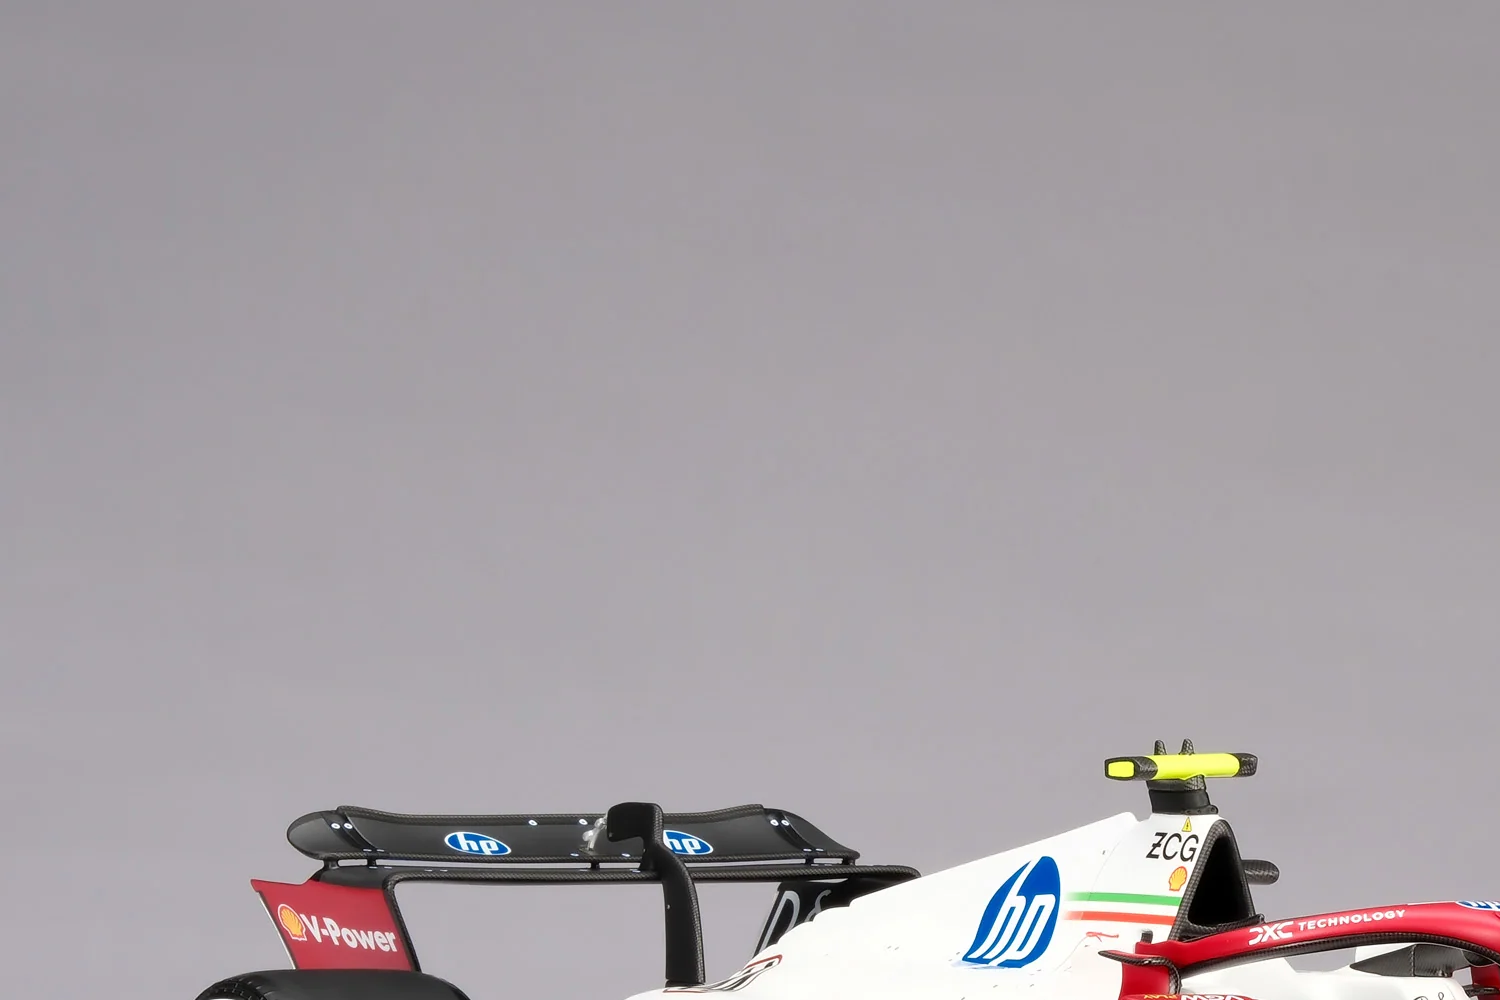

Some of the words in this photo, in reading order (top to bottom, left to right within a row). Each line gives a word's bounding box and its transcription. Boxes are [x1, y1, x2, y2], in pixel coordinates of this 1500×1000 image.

[453, 832, 501, 855] hp
[1145, 831, 1199, 864] ZCG
[967, 857, 1057, 967] hp
[1248, 921, 1294, 946] DXC
[1298, 909, 1406, 931] TECHNOLOGY
[301, 914, 398, 953] V-Power
